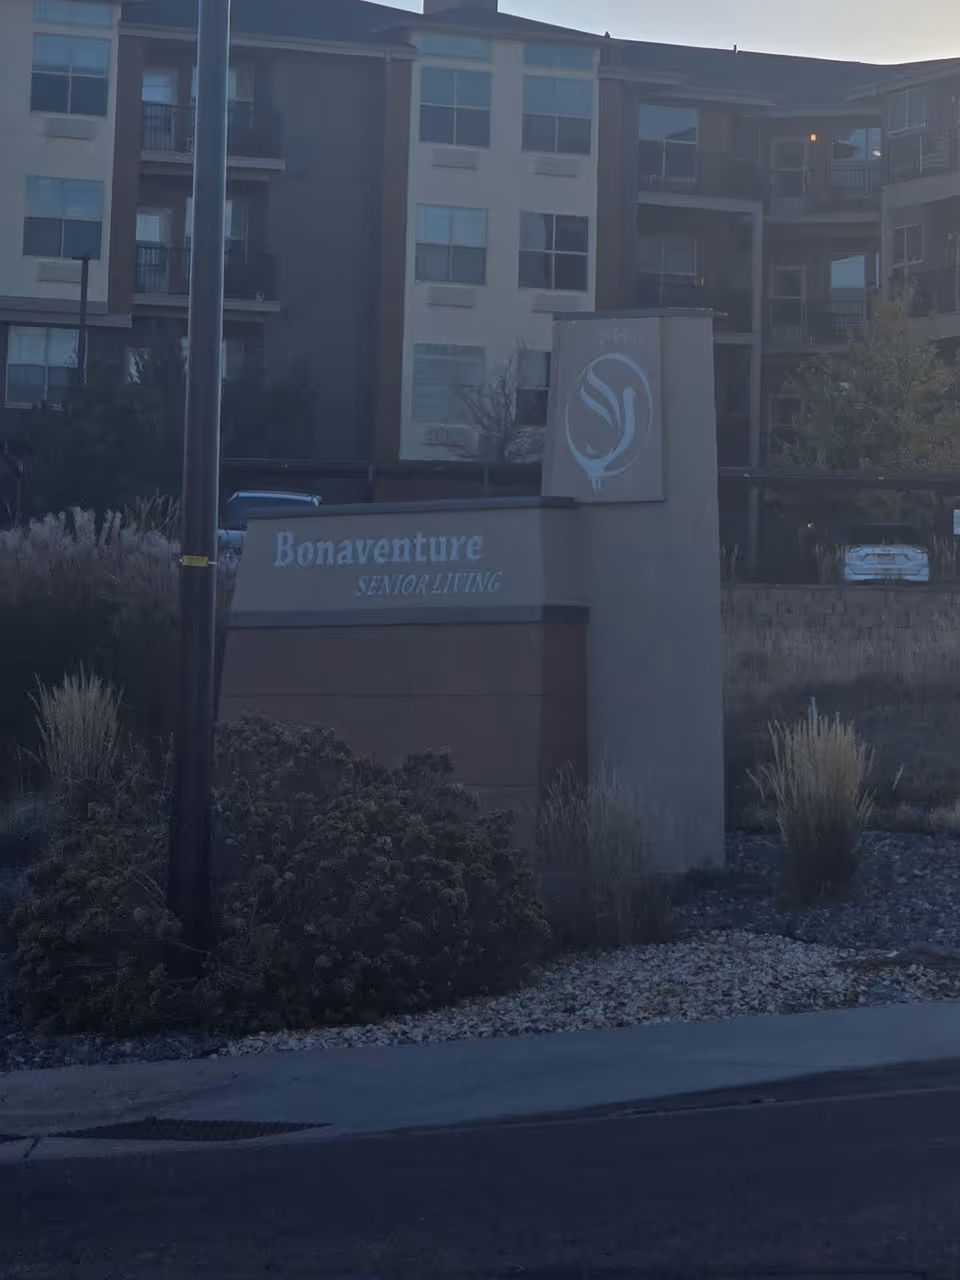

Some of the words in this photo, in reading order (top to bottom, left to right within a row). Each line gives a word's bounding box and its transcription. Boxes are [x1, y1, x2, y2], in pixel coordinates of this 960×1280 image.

[273, 531, 484, 568] Bonaventure
[354, 573, 429, 596] SENIOR
[430, 570, 503, 595] LIVING
